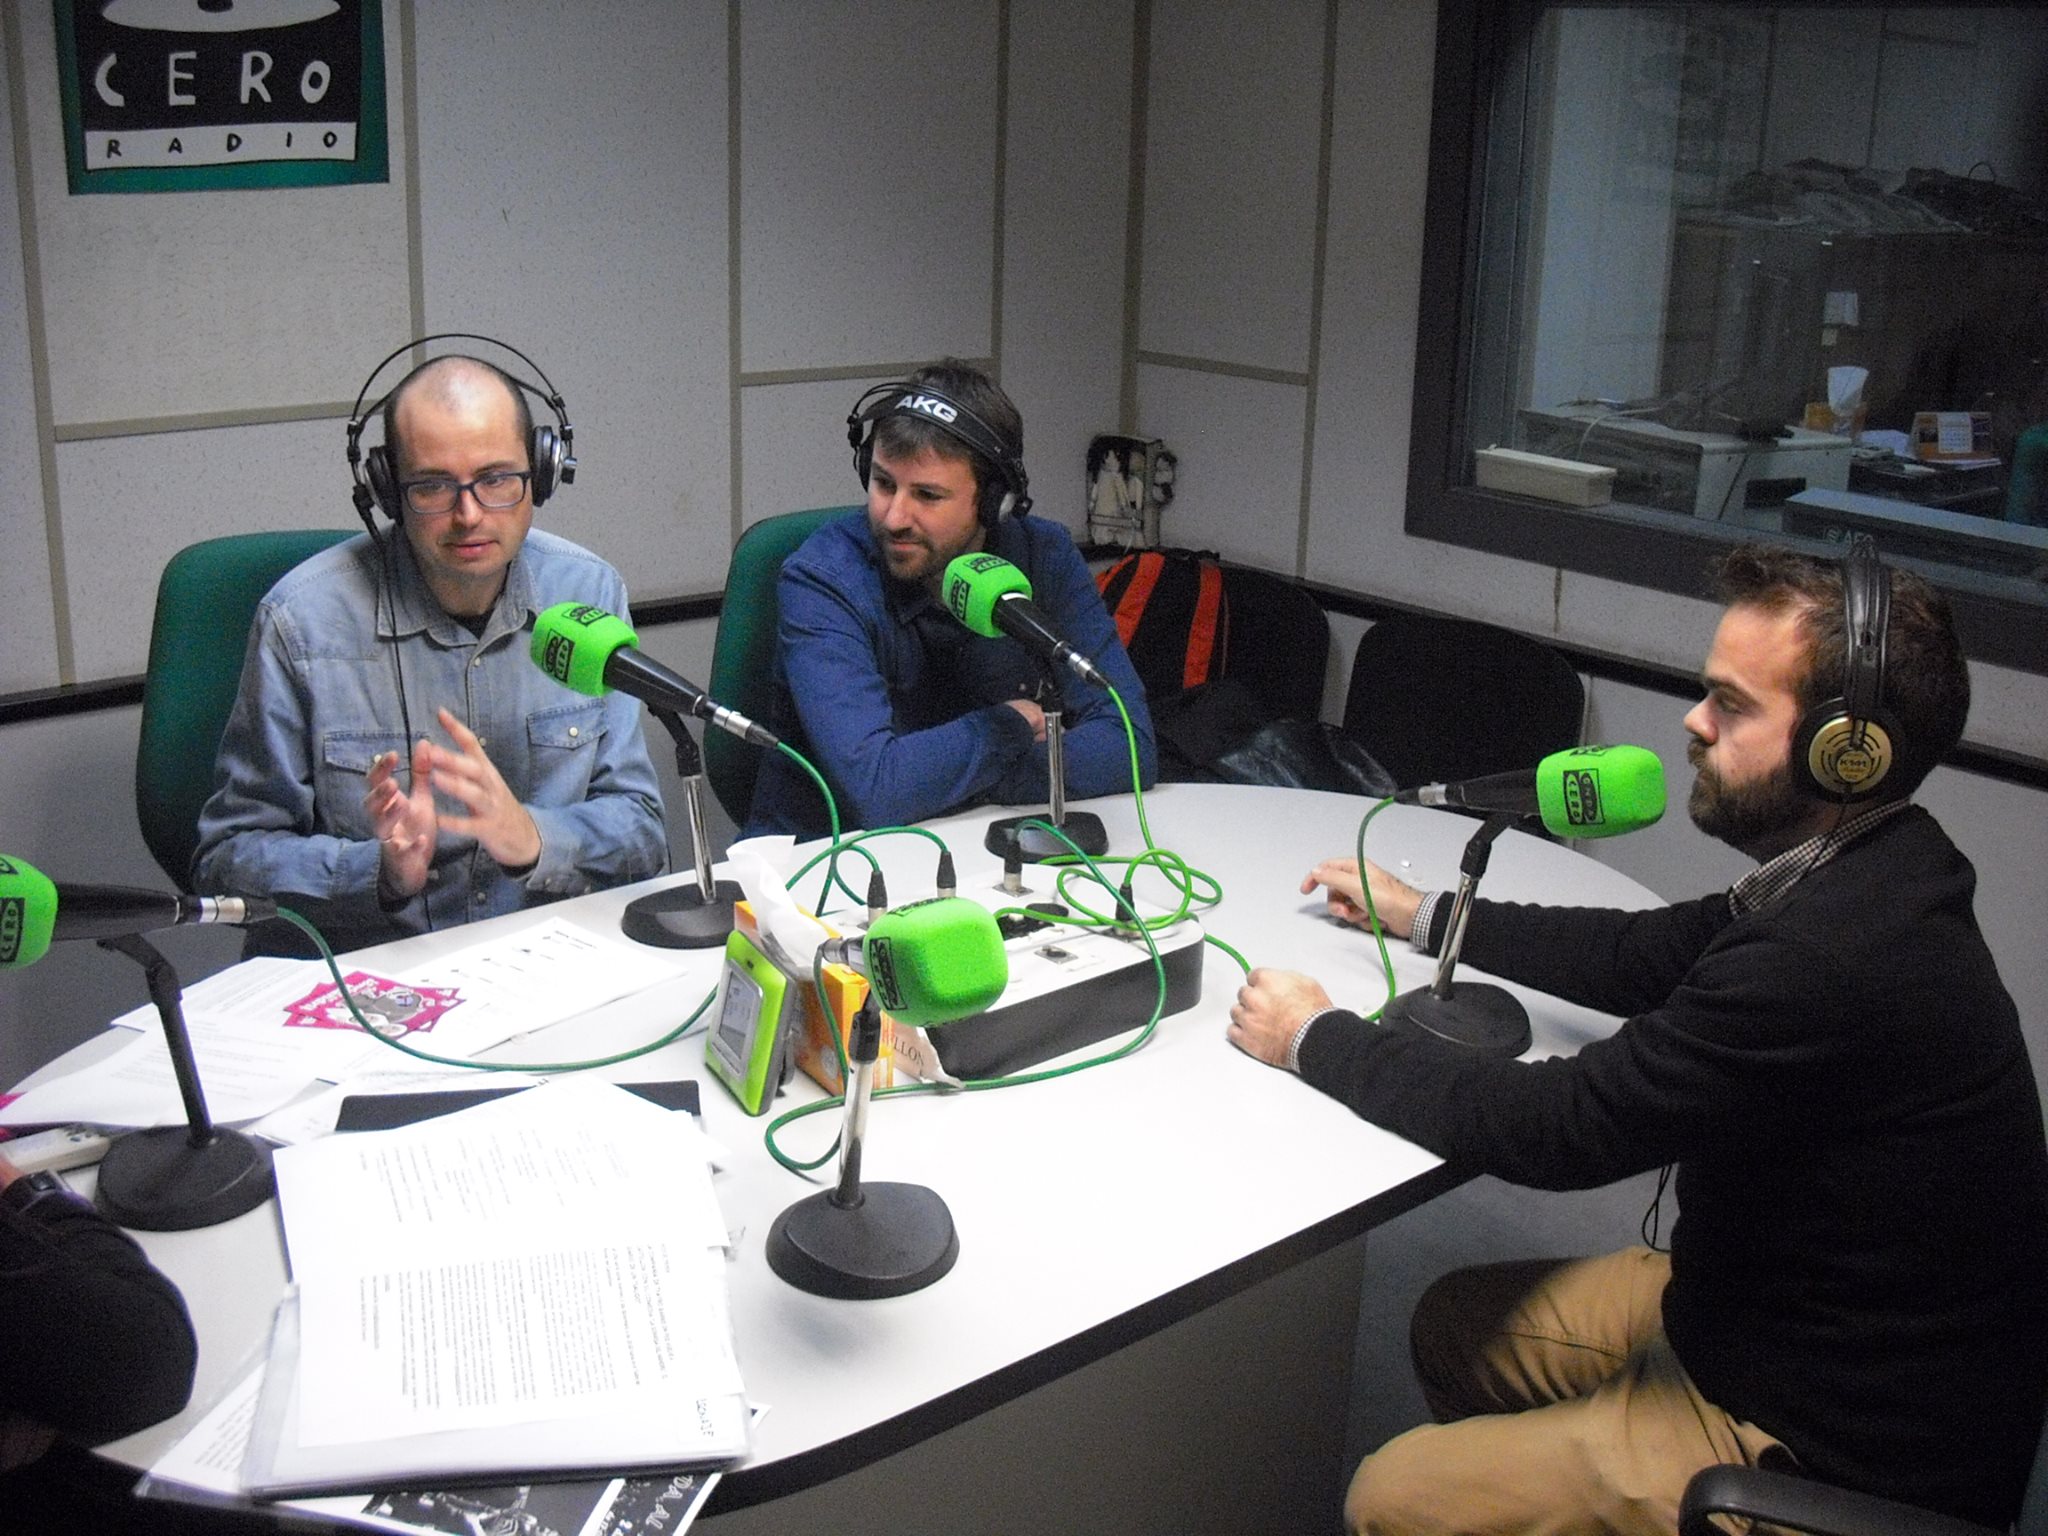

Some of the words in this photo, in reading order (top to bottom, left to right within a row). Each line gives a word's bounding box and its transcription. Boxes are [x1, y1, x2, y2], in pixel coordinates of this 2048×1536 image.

[95, 50, 331, 107] CERO
[106, 131, 338, 160] RADIO
[894, 395, 958, 423] AKG
[1568, 779, 1581, 819] CERO
[1, 908, 17, 952] CERO
